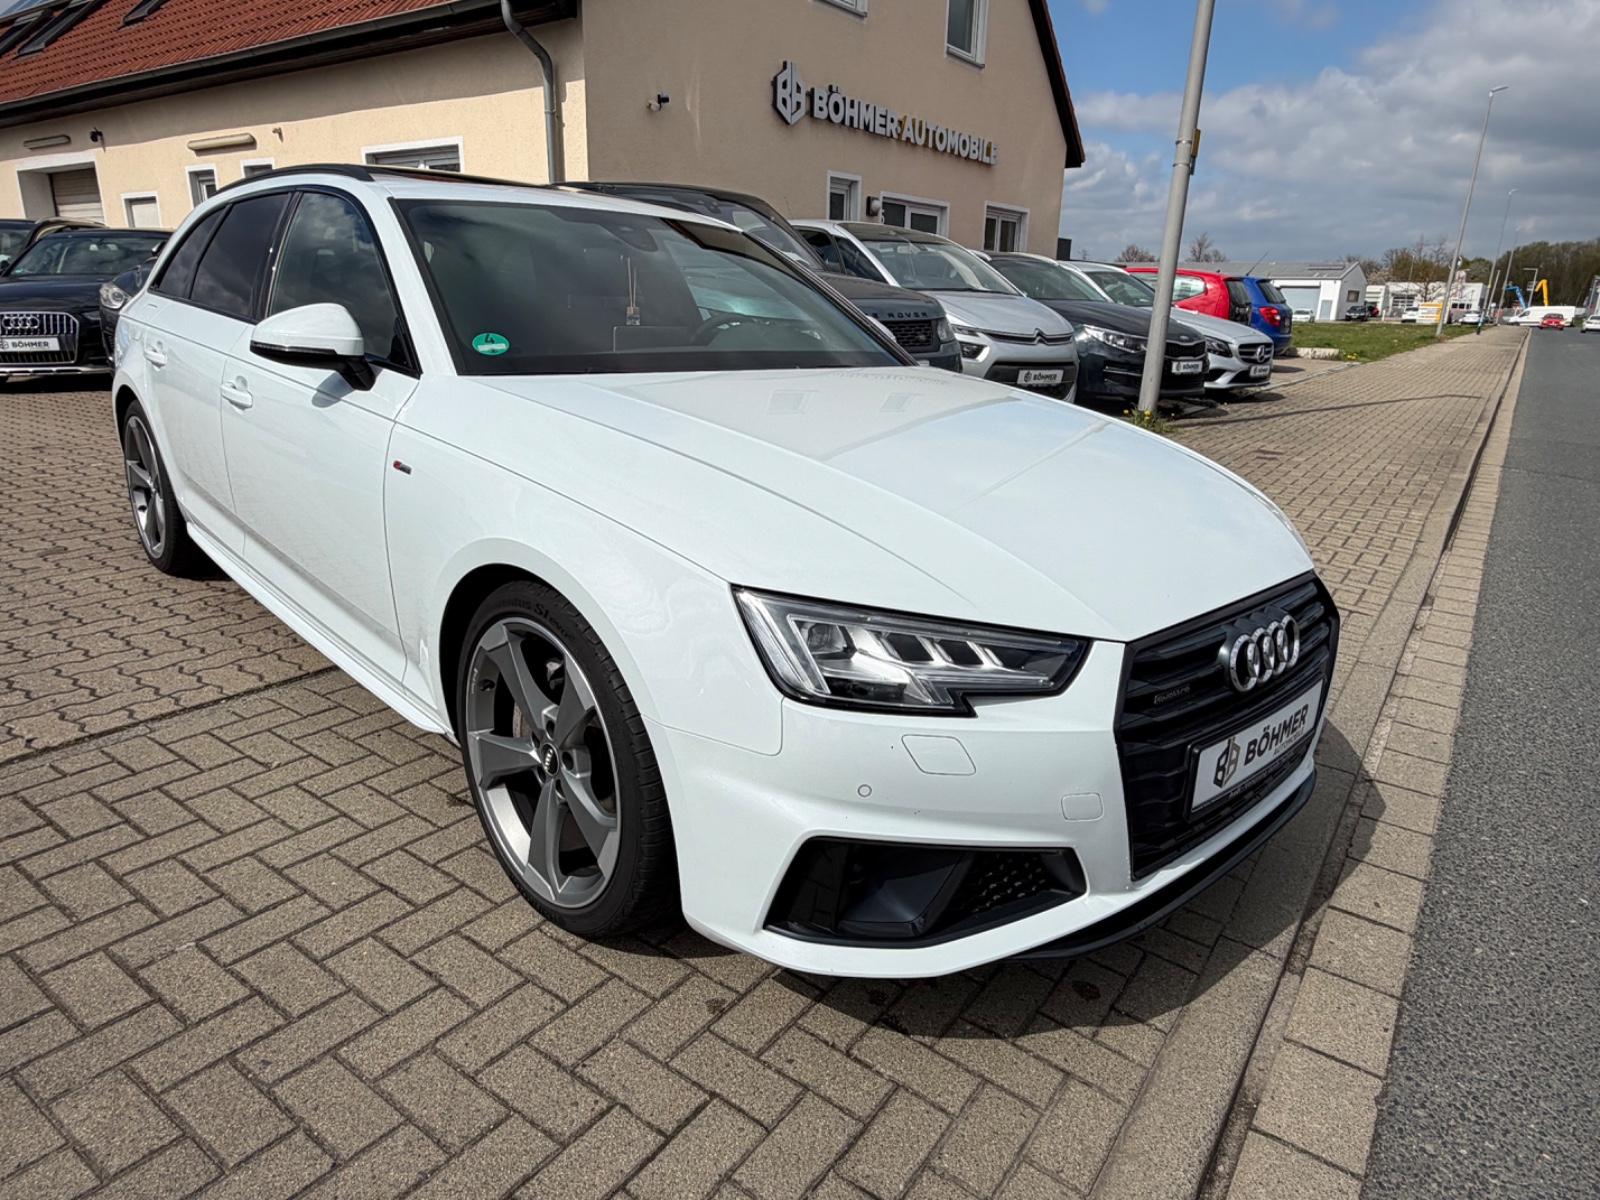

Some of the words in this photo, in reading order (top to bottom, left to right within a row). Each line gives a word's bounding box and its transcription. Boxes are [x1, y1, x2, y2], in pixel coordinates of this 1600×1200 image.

[812, 84, 902, 140] BÖHMER
[901, 114, 998, 165] AUTOMOBILE
[887, 311, 929, 319] ROVER
[11, 340, 49, 349] BÖHMER
[1244, 704, 1309, 766] BÖHMER
